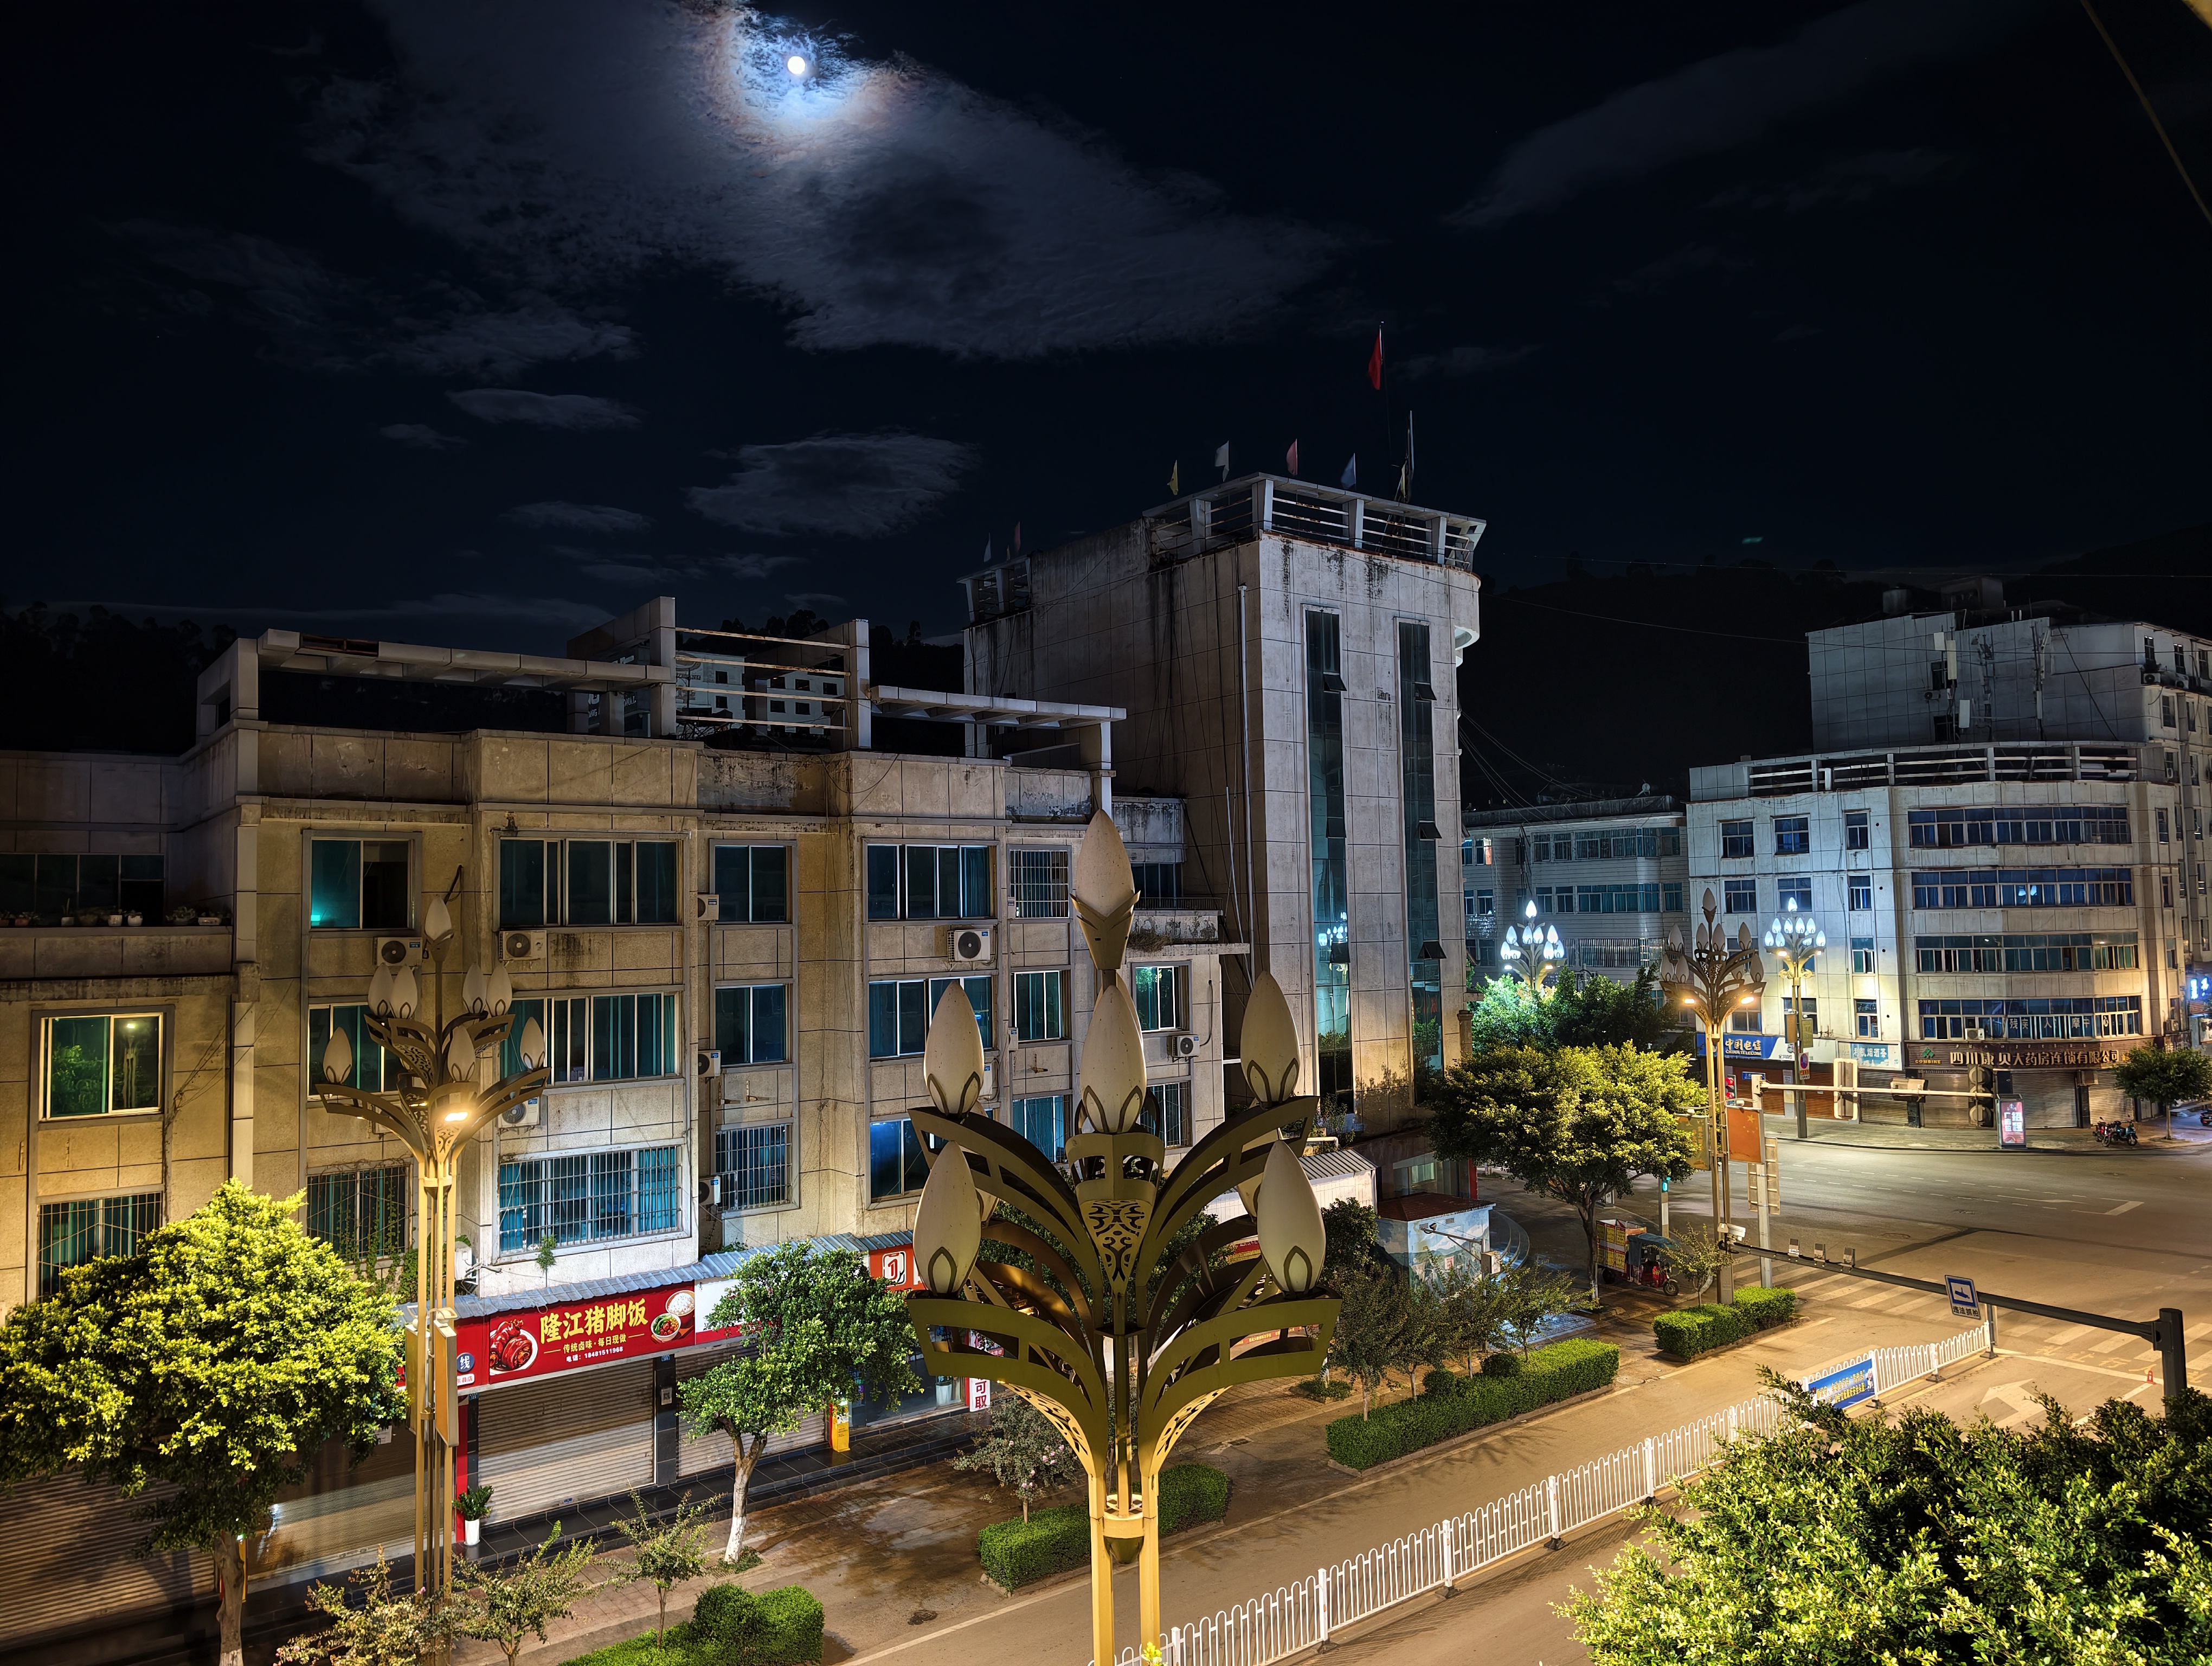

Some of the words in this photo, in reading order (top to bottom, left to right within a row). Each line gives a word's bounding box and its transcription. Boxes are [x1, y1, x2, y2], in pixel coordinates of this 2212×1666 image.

[1725, 1038, 1761, 1051] 中国电信
[1950, 1050, 2119, 1065] 四川康贝大药房连锁有限公司
[1953, 1306, 1979, 1317] 违法抓拍
[540, 1298, 648, 1344] 隆江猪脚饭
[563, 1333, 627, 1354] 传统卤味·每日现做
